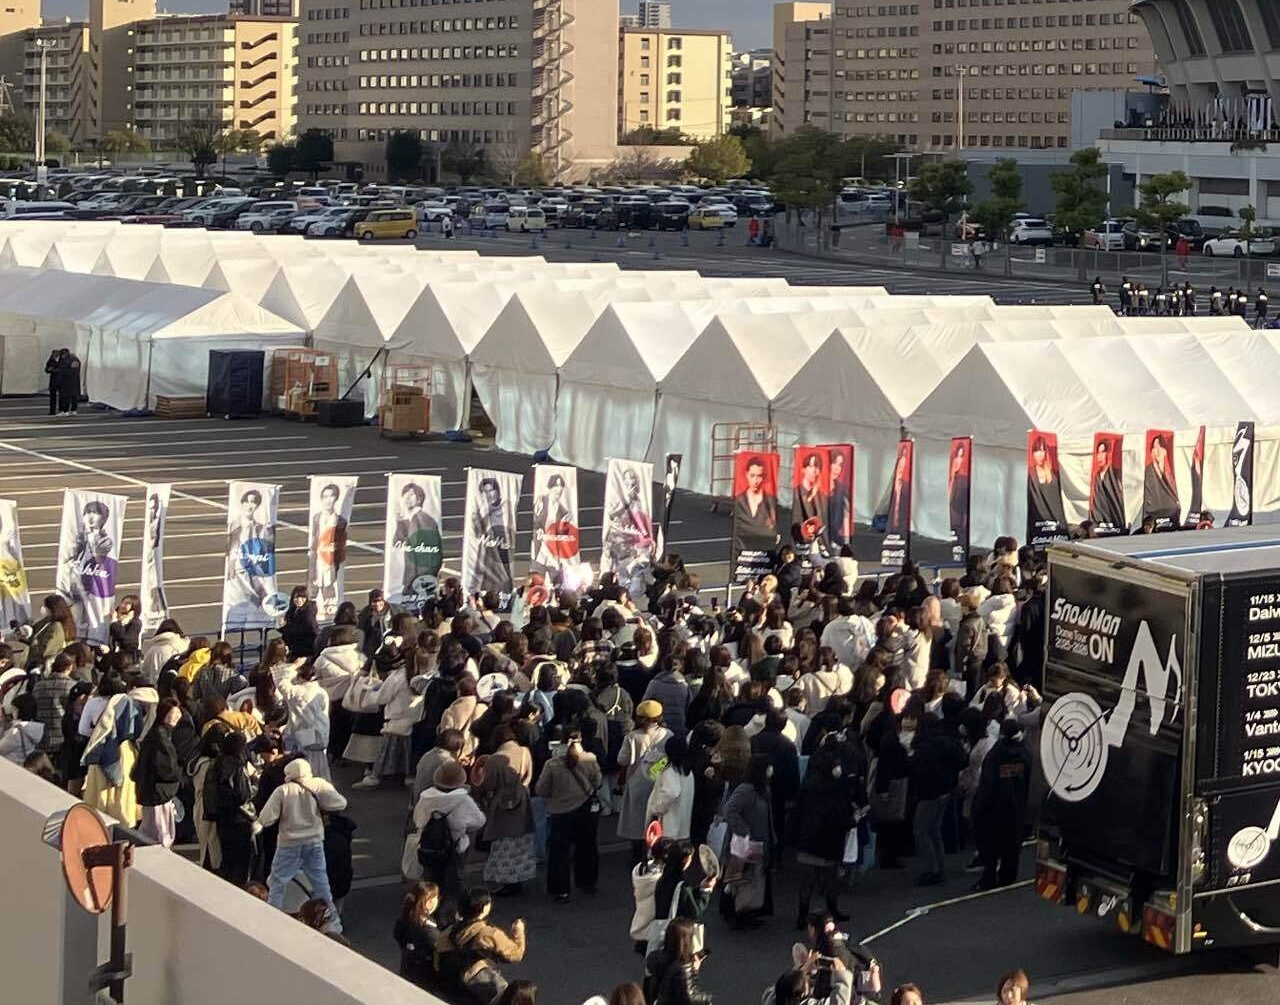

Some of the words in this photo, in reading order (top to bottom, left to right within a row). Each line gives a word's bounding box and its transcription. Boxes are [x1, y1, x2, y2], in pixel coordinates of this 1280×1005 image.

[1249, 593, 1275, 605] 11/15
[1050, 597, 1091, 627] Snow
[1088, 607, 1122, 636] Man
[1089, 633, 1115, 664] ON
[1246, 670, 1276, 683] 12/23
[1245, 710, 1262, 722] 1/4
[1243, 748, 1265, 761] 1/15
